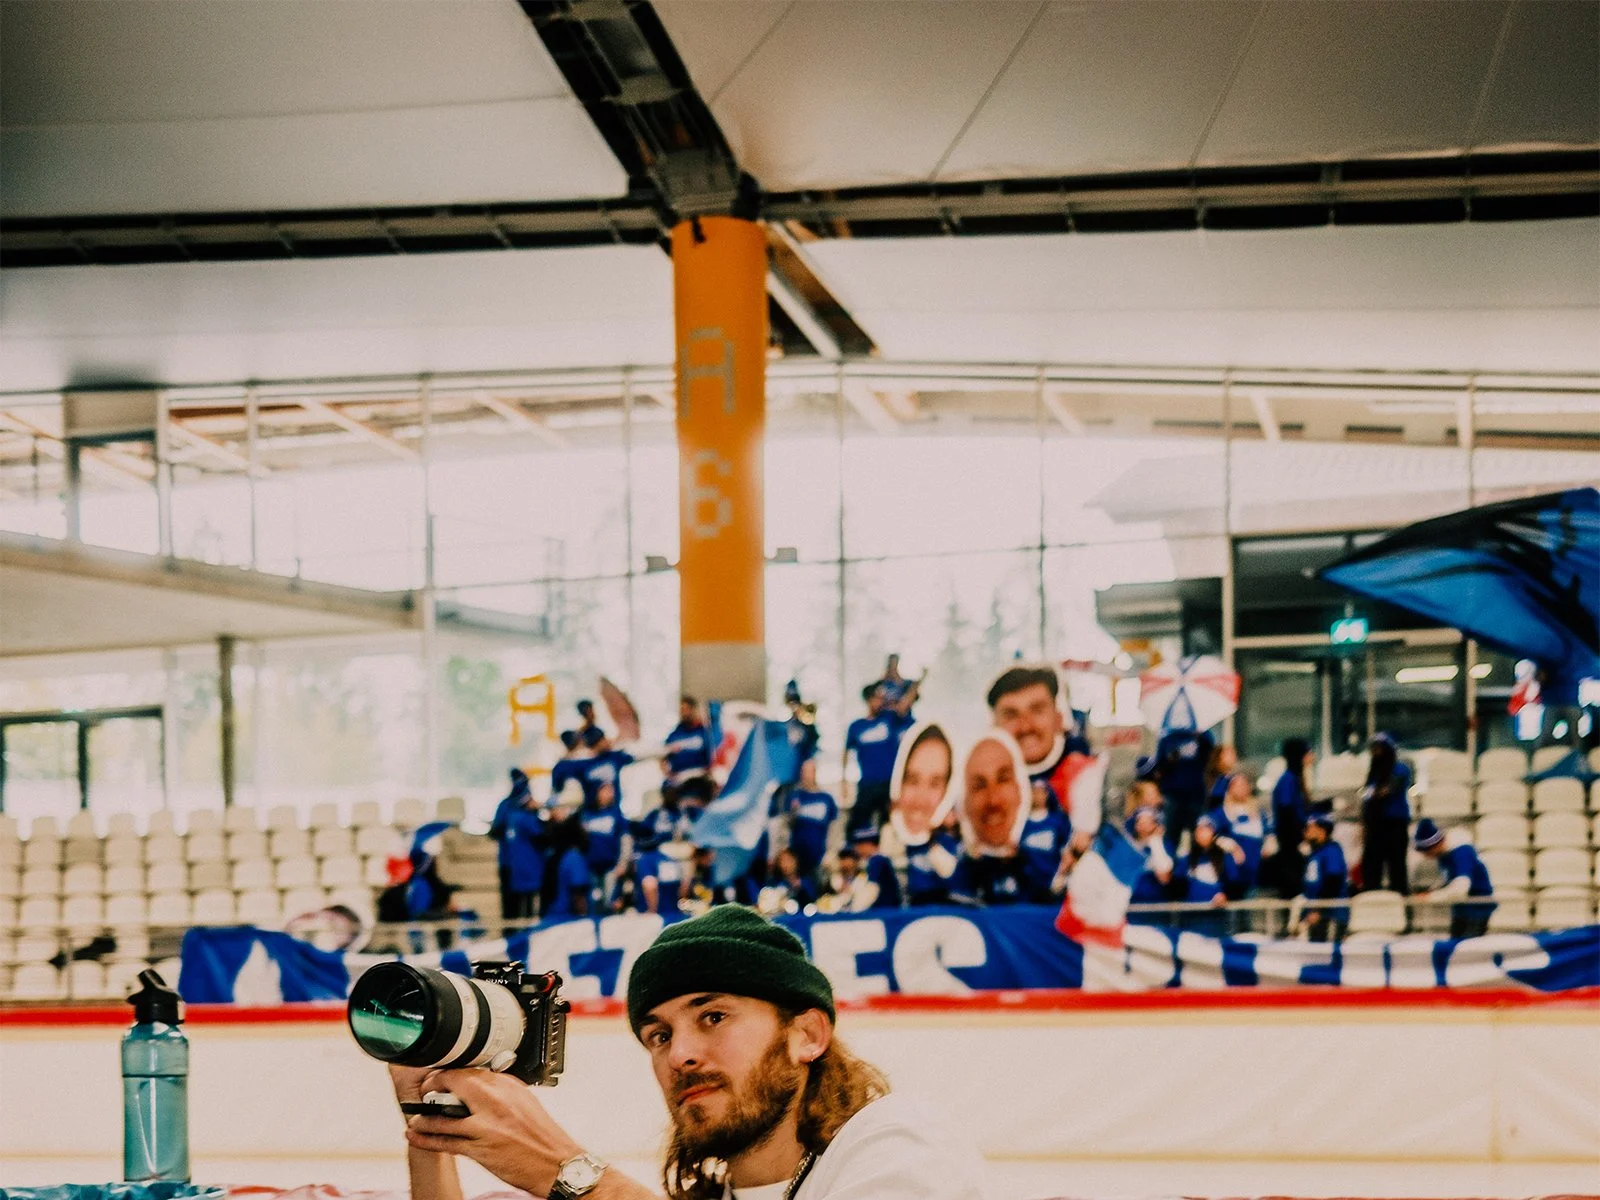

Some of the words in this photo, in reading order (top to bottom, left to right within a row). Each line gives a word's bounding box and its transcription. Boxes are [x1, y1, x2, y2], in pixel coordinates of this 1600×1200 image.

[678, 326, 736, 420] A
[682, 448, 734, 539] 6
[810, 915, 987, 999] ES
